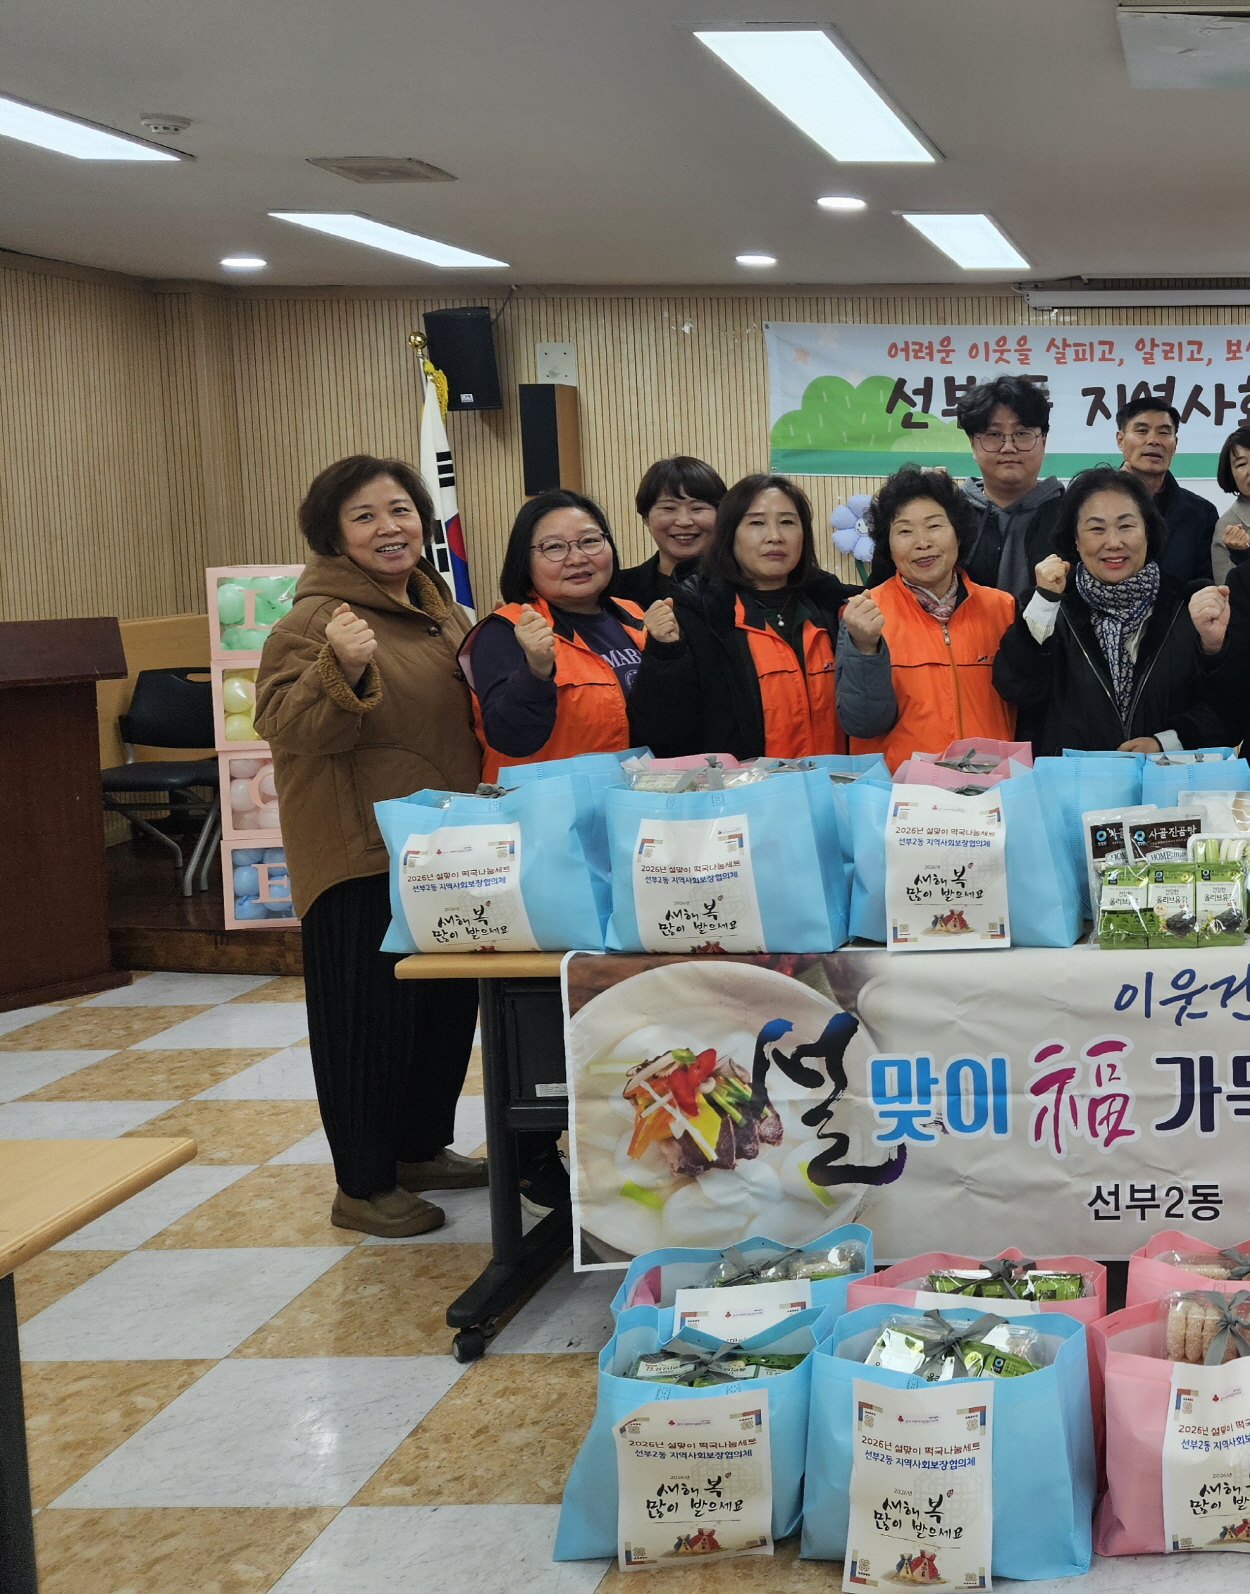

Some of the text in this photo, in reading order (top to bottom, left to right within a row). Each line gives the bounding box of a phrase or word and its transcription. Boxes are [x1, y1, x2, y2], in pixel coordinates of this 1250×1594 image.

[887, 335, 956, 365] 어려운
[968, 334, 1032, 366] 이웃을
[1046, 337, 1124, 367] 살피고,
[1135, 337, 1213, 367] 알리고,
[886, 375, 1053, 430] 선부
[896, 827, 924, 835] 2026년
[926, 827, 949, 835] 설맞이
[899, 838, 991, 848] 선부2동 지역사회보장협의체
[407, 874, 434, 882] 2026년
[436, 872, 459, 881] 설맞이
[645, 871, 739, 885] 선부2동 지역사회보장협의체
[669, 866, 692, 874] 설맞이
[914, 865, 967, 888] 새해 복
[412, 877, 507, 893] 선부2동 지역사회보장협의체
[907, 887, 984, 902] 많이 받으세요
[438, 905, 489, 928] 새해 복
[665, 900, 719, 922] 새해 복
[432, 925, 509, 944] 많이 받으세요
[658, 920, 737, 936] 많이 받으세요
[1029, 1040, 1136, 1155] 福
[1087, 1183, 1224, 1222] 선부2동
[1179, 1425, 1209, 1436] 2026년
[1211, 1423, 1234, 1436] 설맞이
[629, 1440, 664, 1448] 2026년
[668, 1440, 696, 1450] 설맞이
[862, 1436, 892, 1452] 2026년
[894, 1442, 921, 1455] 설맞이
[1181, 1439, 1211, 1452] 선부2동
[635, 1450, 753, 1459] 선부2동 지역사회보장협의체
[865, 1451, 976, 1470] 선부2동 지역사회보장협의체
[657, 1476, 724, 1497] 새해 복
[1200, 1482, 1241, 1497] 새해
[646, 1499, 744, 1519] 많이 받으세요
[883, 1495, 943, 1523] 새해 복
[1190, 1500, 1221, 1515] 많이
[874, 1510, 963, 1540] 많이 받으세요
